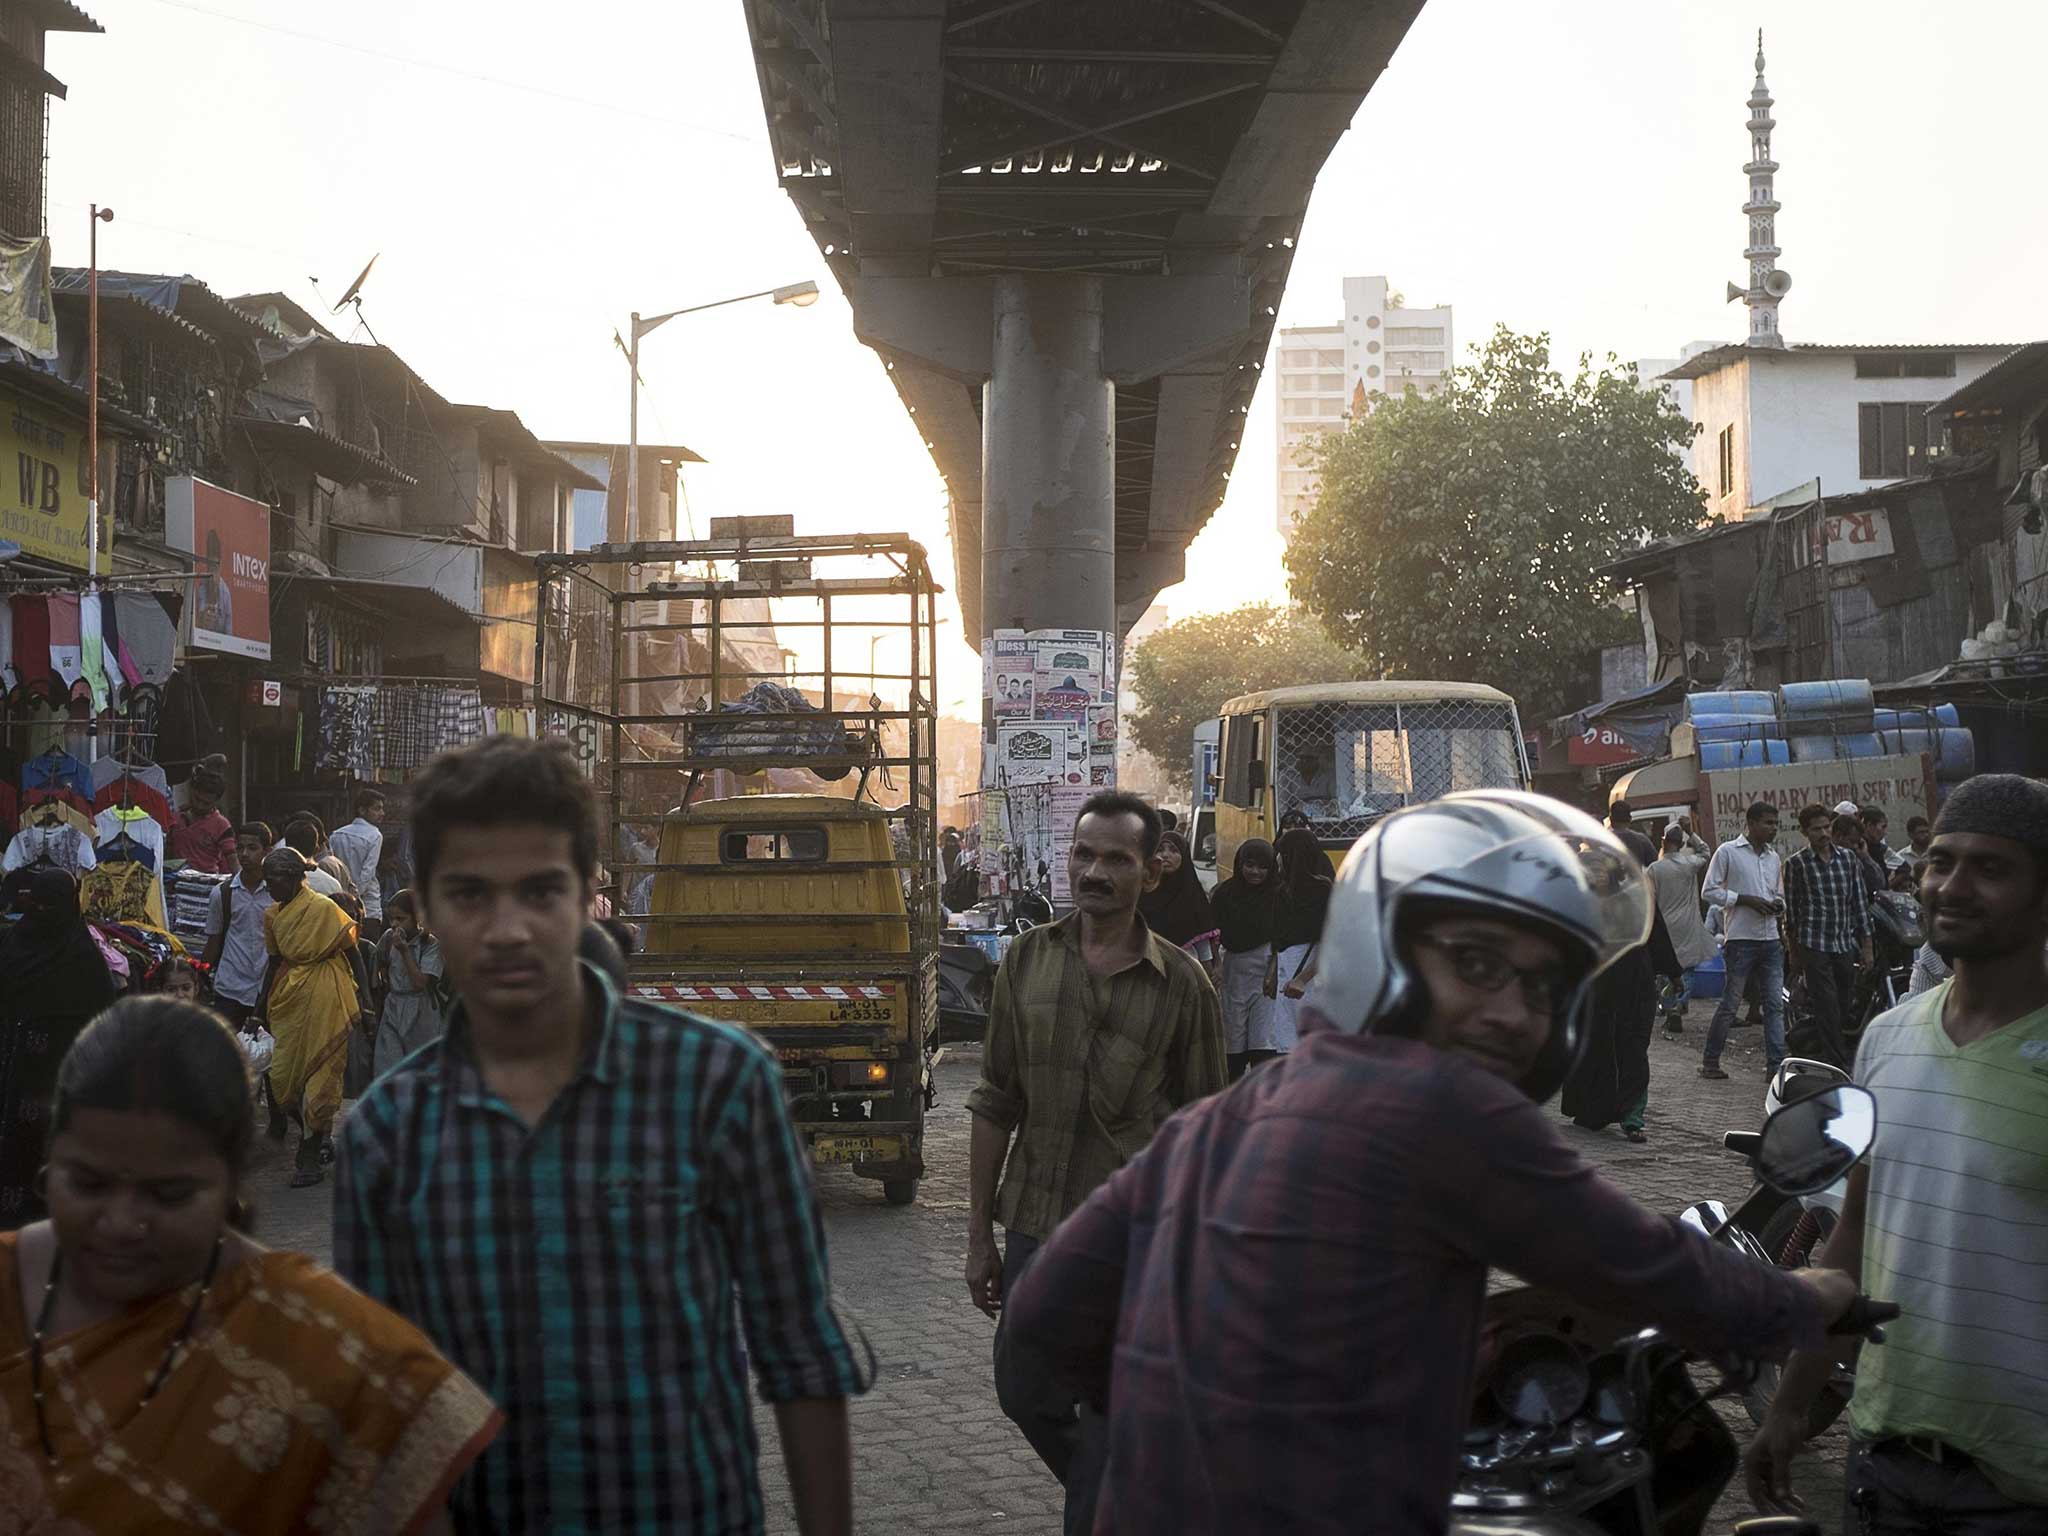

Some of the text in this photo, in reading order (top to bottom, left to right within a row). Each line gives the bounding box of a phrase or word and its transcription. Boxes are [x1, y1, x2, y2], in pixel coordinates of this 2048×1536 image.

[18, 452, 60, 517] WB
[997, 640, 1025, 651] Bless
[1717, 791, 1758, 815] HOLY
[1763, 787, 1809, 810] MARY
[1815, 784, 1858, 806] TEMPO
